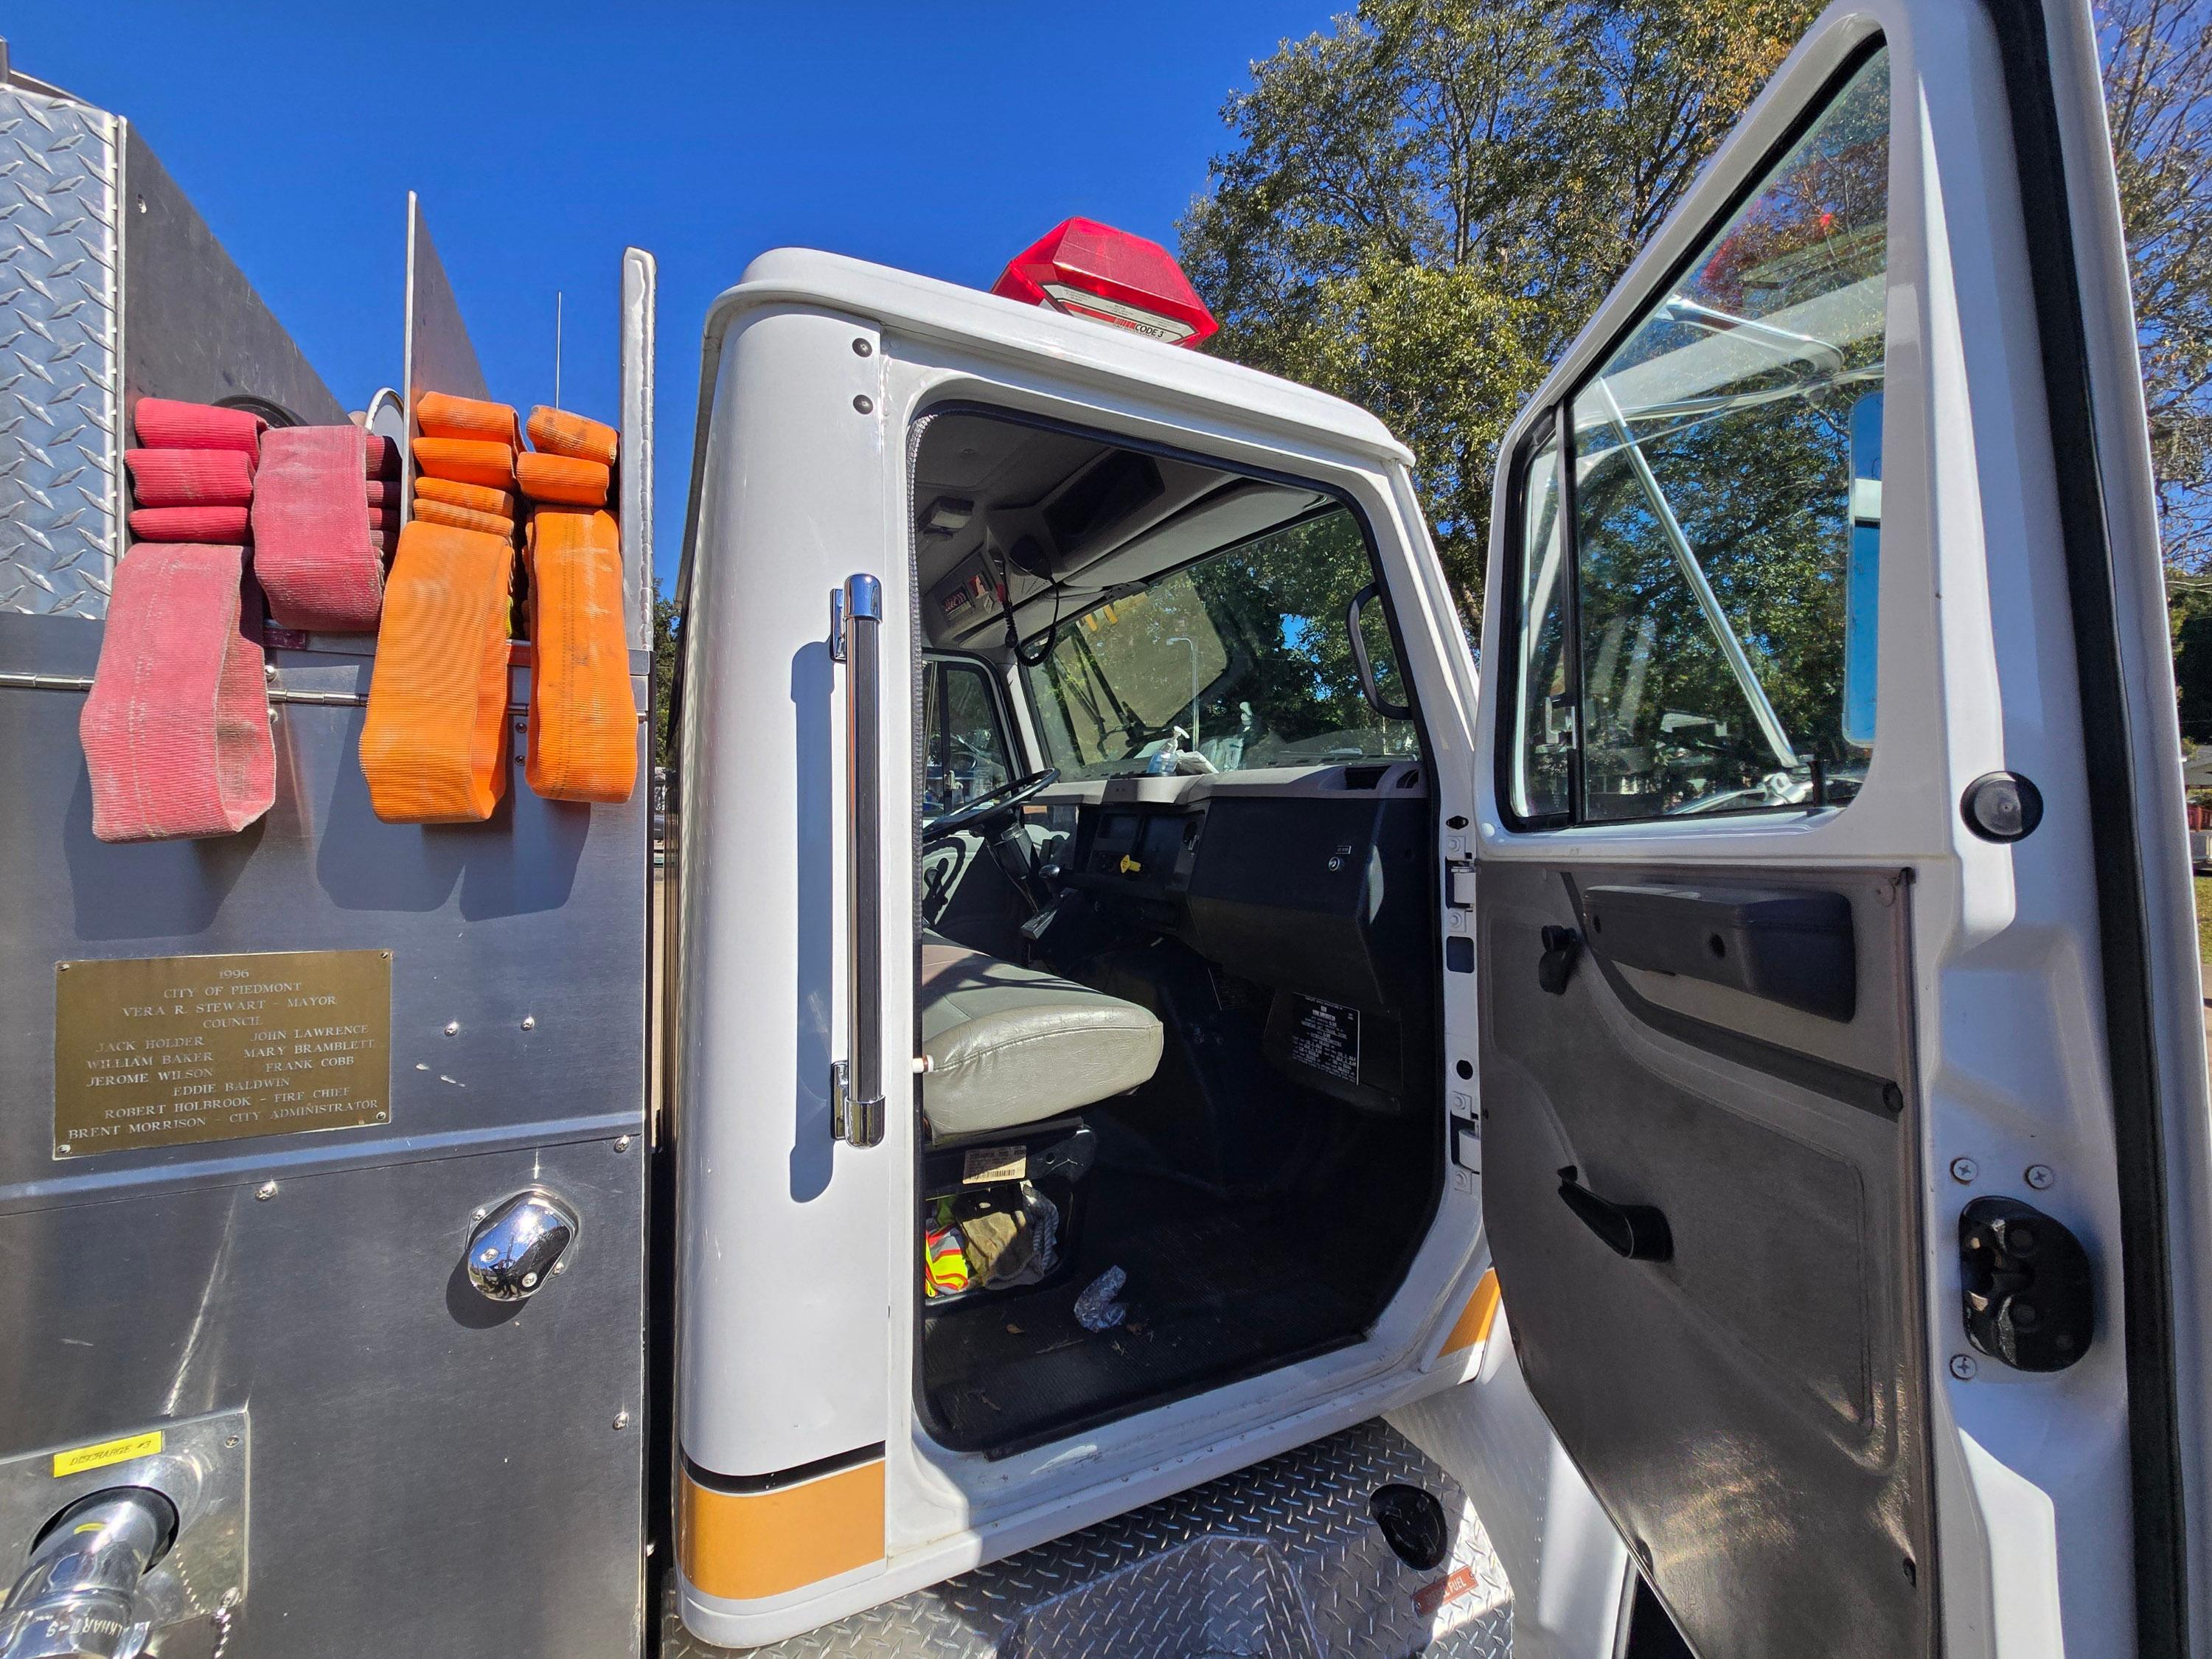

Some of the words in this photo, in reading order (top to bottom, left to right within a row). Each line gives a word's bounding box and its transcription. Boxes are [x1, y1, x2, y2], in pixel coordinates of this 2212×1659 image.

[1135, 324, 1158, 336] CODE
[219, 970, 249, 979] 1996
[164, 988, 195, 998] CITY
[205, 986, 223, 996] OF
[231, 982, 302, 995] PIEDMONT
[122, 1006, 166, 1017] VERA
[196, 1001, 265, 1014] STEWART
[288, 995, 337, 1008] MAYOR
[203, 1016, 262, 1029] COUNCIL
[250, 1031, 288, 1042] JOHN
[294, 1025, 369, 1039] LAWRENCE
[95, 1041, 136, 1052] JACK
[145, 1037, 204, 1049] HOLDER
[243, 1046, 287, 1058] MARY
[294, 1039, 375, 1054] BRAMBLETT
[86, 1056, 153, 1069] WILLIAM
[161, 1051, 214, 1065] BAKER
[265, 1060, 313, 1073] FRANK
[321, 1056, 355, 1068] COBB
[86, 1073, 149, 1087] JEROME
[158, 1068, 214, 1081] WILSON
[173, 1084, 216, 1096] EDDIE
[225, 1077, 291, 1092] BALDWIN
[105, 1105, 167, 1119] ROBERT
[175, 1096, 251, 1113] HOLBROOK
[274, 1091, 305, 1103] FIRE
[313, 1087, 350, 1099] CHIEF
[69, 1125, 122, 1140] BRENT
[129, 1117, 206, 1134] MORRISON
[229, 1111, 261, 1123] CITY
[271, 1099, 378, 1120] ADMINISTRATOR
[69, 1445, 133, 1466] DISCHARGE
[1447, 1576, 1467, 1593] FUEL
